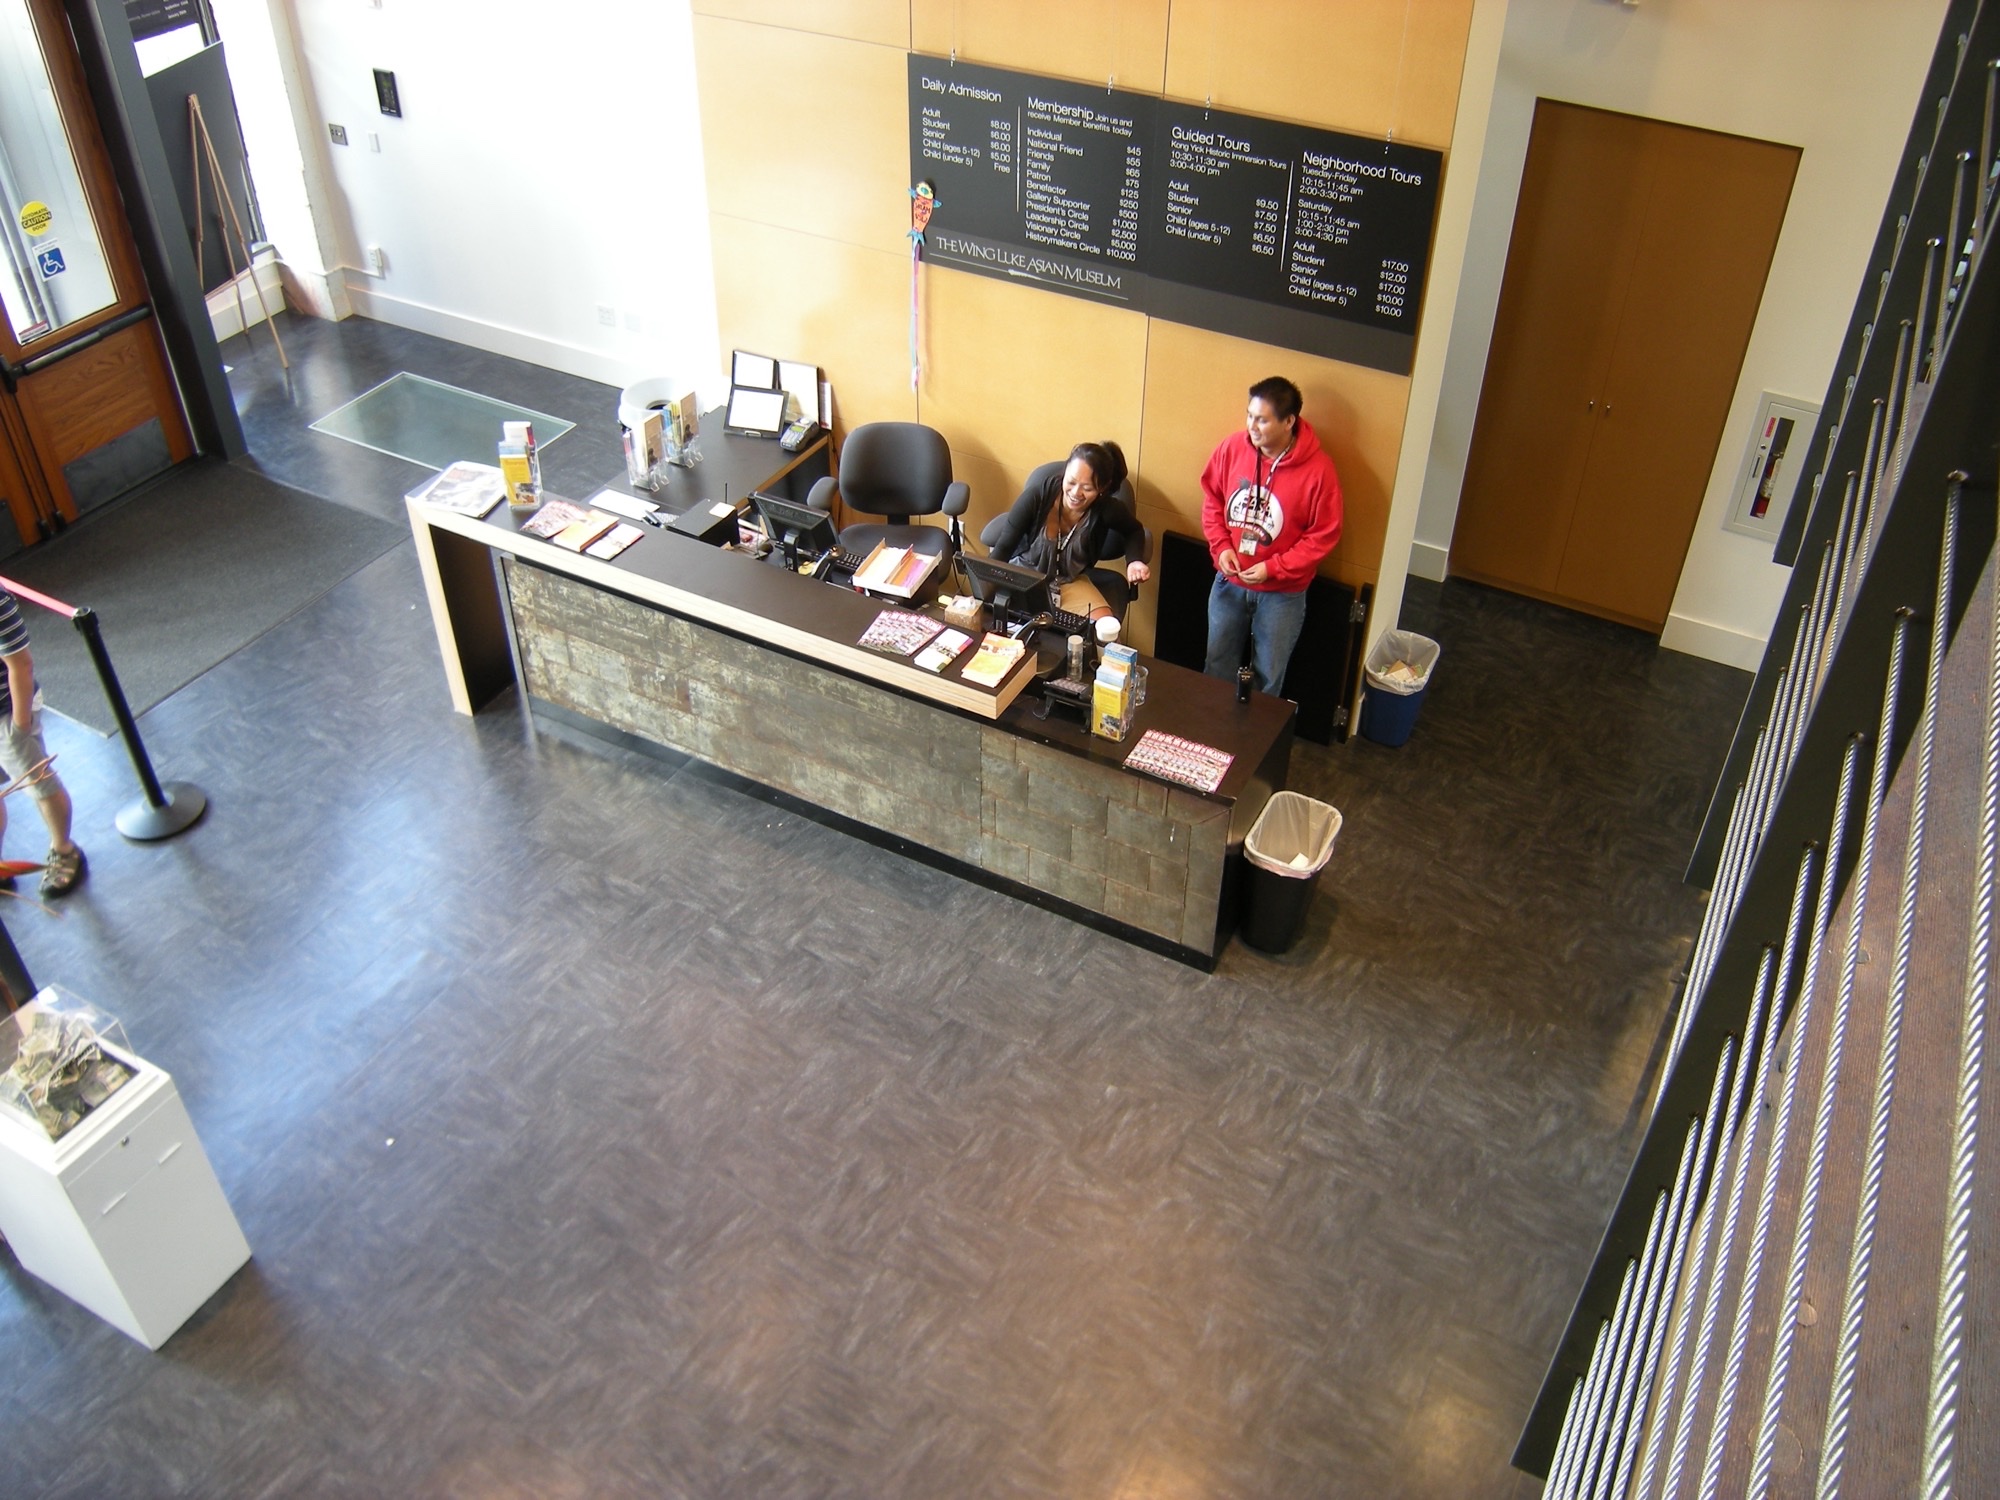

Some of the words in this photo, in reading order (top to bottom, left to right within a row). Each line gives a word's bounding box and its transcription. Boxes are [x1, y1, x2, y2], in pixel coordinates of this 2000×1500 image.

[922, 77, 946, 94] Daily
[949, 84, 1002, 102] Admission
[922, 107, 941, 118] Adult
[1028, 97, 1093, 119] Membership
[1095, 115, 1109, 124] Join
[1119, 119, 1132, 127] and
[922, 118, 950, 130] Student
[991, 120, 1011, 131] $8.00
[1028, 111, 1051, 121] receive
[1053, 115, 1081, 127] Member
[1083, 120, 1110, 132] benefits
[1112, 126, 1132, 137] today
[922, 128, 945, 139] Senior
[991, 131, 1011, 141] $6.00
[1027, 128, 1062, 141] Individual
[1172, 127, 1214, 145] Guided
[1217, 136, 1250, 153] Tours
[923, 139, 941, 150] Child
[942, 142, 961, 155] (ages
[963, 146, 980, 158] 5-12)
[991, 142, 1011, 152] $6.00
[1027, 138, 1057, 152] National
[1059, 144, 1083, 156] Friend
[1127, 146, 1141, 156] $45
[923, 150, 941, 160] Child
[943, 152, 964, 164] (under
[965, 157, 973, 167] 5)
[991, 152, 1011, 163] $5.00
[1027, 149, 1054, 161] Friends
[1171, 140, 1189, 152] Kong
[1190, 143, 1204, 154] Yick
[1206, 147, 1230, 160] Historic
[1232, 152, 1267, 167] Immersion
[1269, 159, 1287, 170] Tours
[1171, 151, 1216, 167] 10:30-11:30
[1217, 161, 1230, 169] am
[994, 163, 1010, 173] Free
[1027, 160, 1051, 172] Family
[1126, 157, 1141, 167] $55
[1169, 160, 1206, 173] 3:00-4:00
[1207, 167, 1220, 177] pm
[1126, 168, 1140, 177] $65
[1302, 166, 1357, 185] Tuesday-Friday
[1303, 152, 1386, 179] Neighborhood
[1389, 169, 1422, 186] Tours
[1027, 170, 1051, 182] Patron
[1026, 180, 1067, 195] Benefactor
[1125, 178, 1139, 188] $75
[1168, 180, 1189, 192] Adult
[1301, 177, 1350, 193] 10:15-11:45
[1351, 186, 1363, 196] am
[1026, 190, 1051, 204] Gallery
[1052, 195, 1091, 210] Supporter
[1121, 188, 1139, 199] $125
[1168, 192, 1199, 206] Student
[1299, 185, 1337, 200] 2:00-3:30
[1339, 194, 1352, 203] pm
[1026, 201, 1066, 216] President's
[1068, 209, 1089, 221] Circle
[1120, 199, 1138, 210] $250
[1167, 203, 1193, 216] Senior
[1256, 199, 1278, 211] $9.50
[1298, 199, 1332, 214] Saturday
[22, 206, 48, 220] AUTOMATIC
[1119, 209, 1138, 220] $500
[1255, 210, 1277, 222] $7.50
[23, 212, 51, 228] CAUTION
[1026, 211, 1066, 227] Leadership
[1068, 219, 1089, 231] Circle
[1112, 219, 1137, 231] $1,000
[1166, 214, 1187, 226] Child
[1188, 217, 1209, 231] (ages
[1210, 222, 1231, 235] 5-12)
[1297, 210, 1346, 228] 10:15-11:45
[1347, 221, 1360, 230] am
[32, 223, 47, 232] DOOR
[1026, 222, 1059, 237] Visionary
[1060, 228, 1081, 240] Circle
[1254, 221, 1276, 233] $7.50
[1296, 219, 1334, 234] 1:00-2:30
[1335, 227, 1349, 237] pm
[1112, 229, 1136, 241] $2,500
[1166, 225, 1186, 237] Child
[1187, 228, 1213, 243] (under
[1214, 234, 1222, 245] 5)
[1253, 232, 1275, 245] $6.50
[1295, 227, 1333, 242] 3:00-4:30
[1334, 235, 1348, 245] pm
[1025, 232, 1077, 250] Historymakers
[1079, 242, 1100, 254] Circle
[1111, 239, 1136, 251] $5,000
[1252, 243, 1274, 256] $6.50
[1293, 240, 1315, 252] Adult
[1106, 248, 1136, 261] $10,000
[1292, 252, 1325, 267] Student
[936, 237, 958, 252] THE
[957, 240, 995, 260] WING
[998, 248, 1025, 267] LUKE
[1026, 258, 1064, 276] ASIAN
[1064, 265, 1121, 289] MUSEUM
[1291, 263, 1318, 276] Senior
[1382, 259, 1409, 273] $17.00
[1380, 271, 1407, 284] $12.00
[1290, 274, 1311, 287] Child
[1312, 279, 1334, 293] (ages
[1336, 284, 1358, 297] 5-12)
[1378, 282, 1405, 295] $17.00
[1288, 286, 1310, 298] Child
[1311, 290, 1337, 303] (under
[1338, 295, 1347, 306] 5)
[1377, 293, 1404, 307] $10.00
[1375, 305, 1402, 318] $10.00
